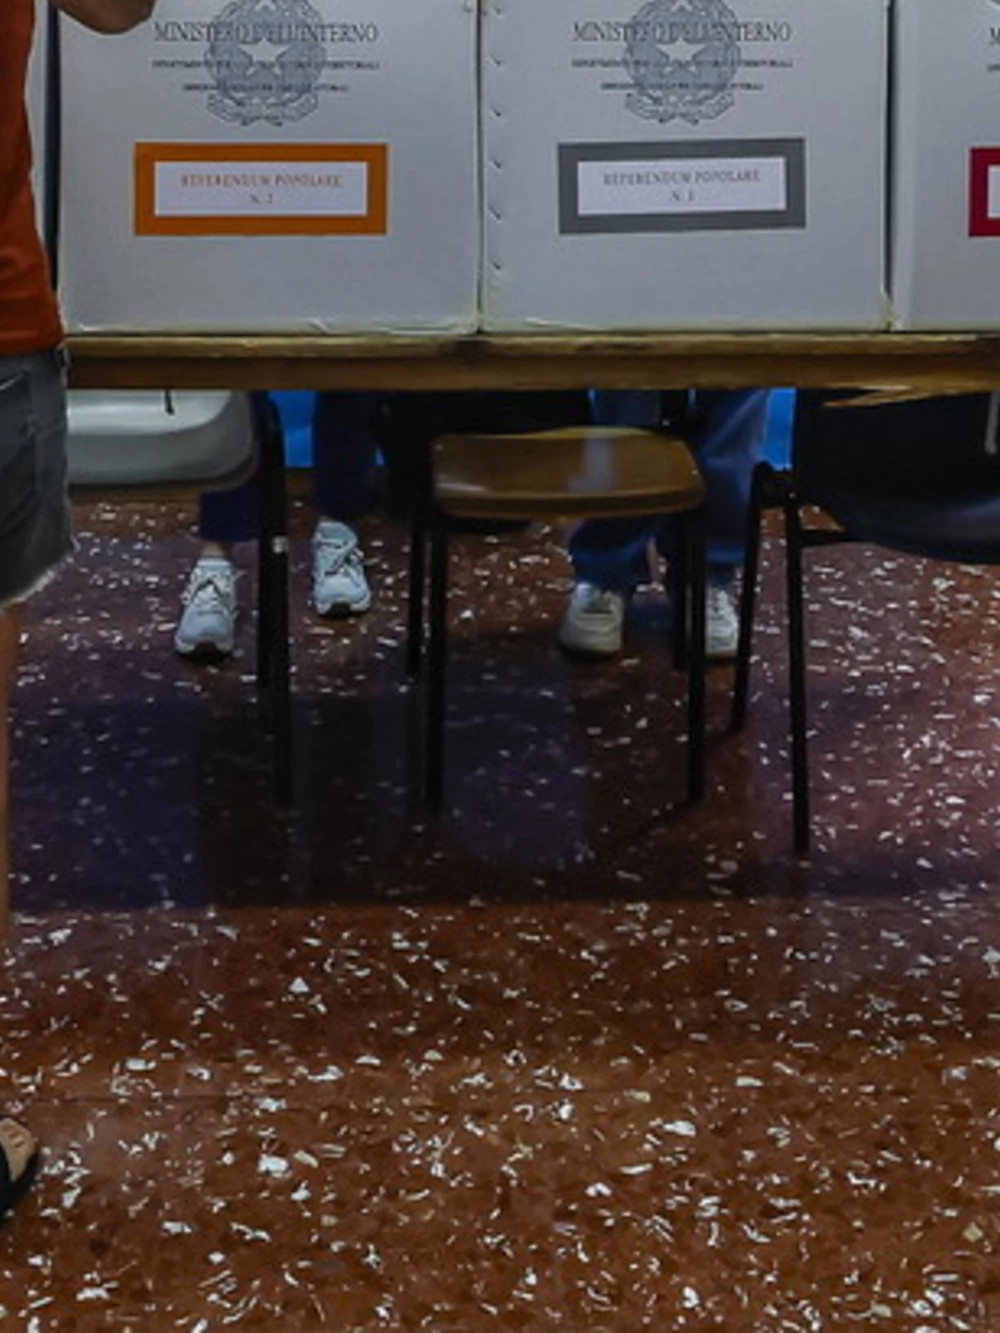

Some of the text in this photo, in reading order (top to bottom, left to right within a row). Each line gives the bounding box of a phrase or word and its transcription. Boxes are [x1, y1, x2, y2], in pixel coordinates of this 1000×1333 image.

[181, 174, 342, 188] REFERENDUM POPOLARE
[603, 169, 761, 186] REFERENDUM POPOLARE
